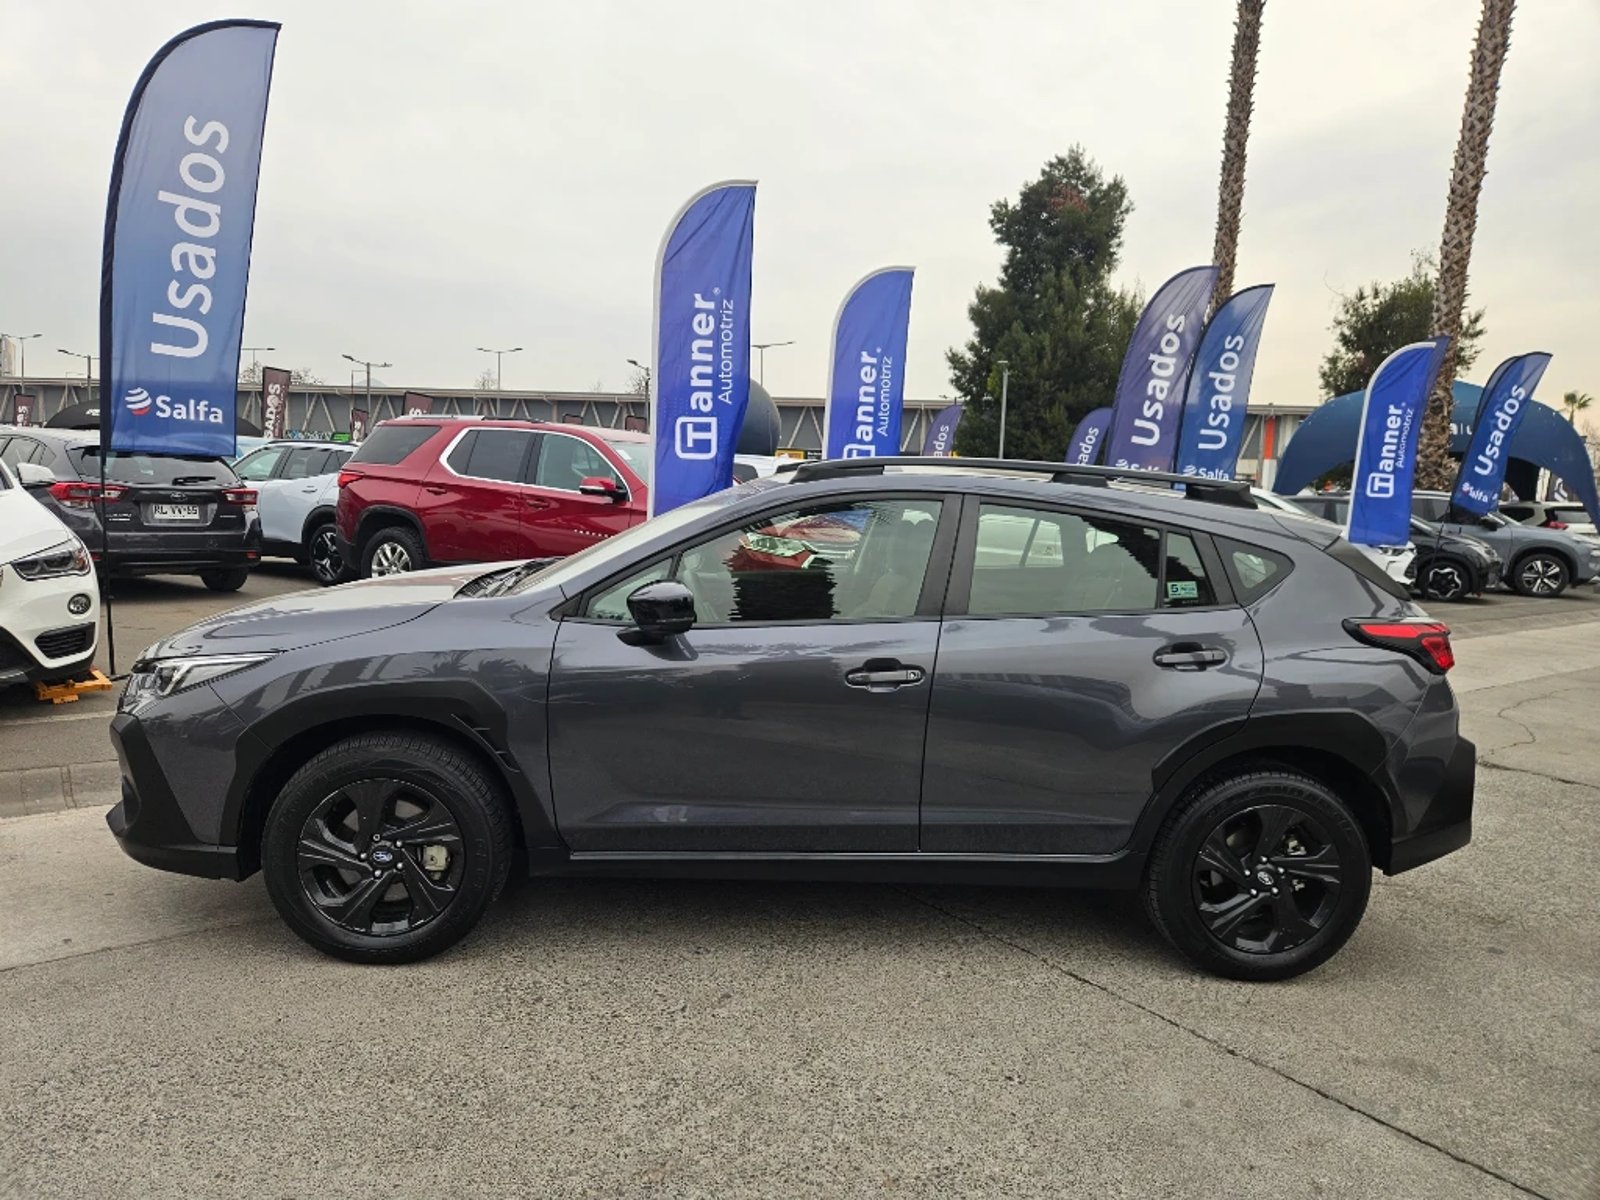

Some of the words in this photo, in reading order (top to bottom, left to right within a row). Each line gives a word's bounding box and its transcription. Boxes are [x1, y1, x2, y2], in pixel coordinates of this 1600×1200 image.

[151, 115, 229, 358] Usados
[675, 293, 718, 460] Tanner
[717, 299, 734, 404] Automotriz
[1131, 313, 1186, 447] Usados
[1198, 335, 1245, 450] Usados
[156, 394, 223, 424] Salfa
[264, 383, 281, 439] SADOS
[876, 356, 892, 437] Automotriz
[1395, 408, 1415, 468] Automotriz
[1474, 385, 1526, 476] Usados
[933, 425, 950, 458] ados
[1076, 426, 1100, 465] ados
[1198, 467, 1229, 481] Salfa
[1366, 404, 1402, 498] Tanner
